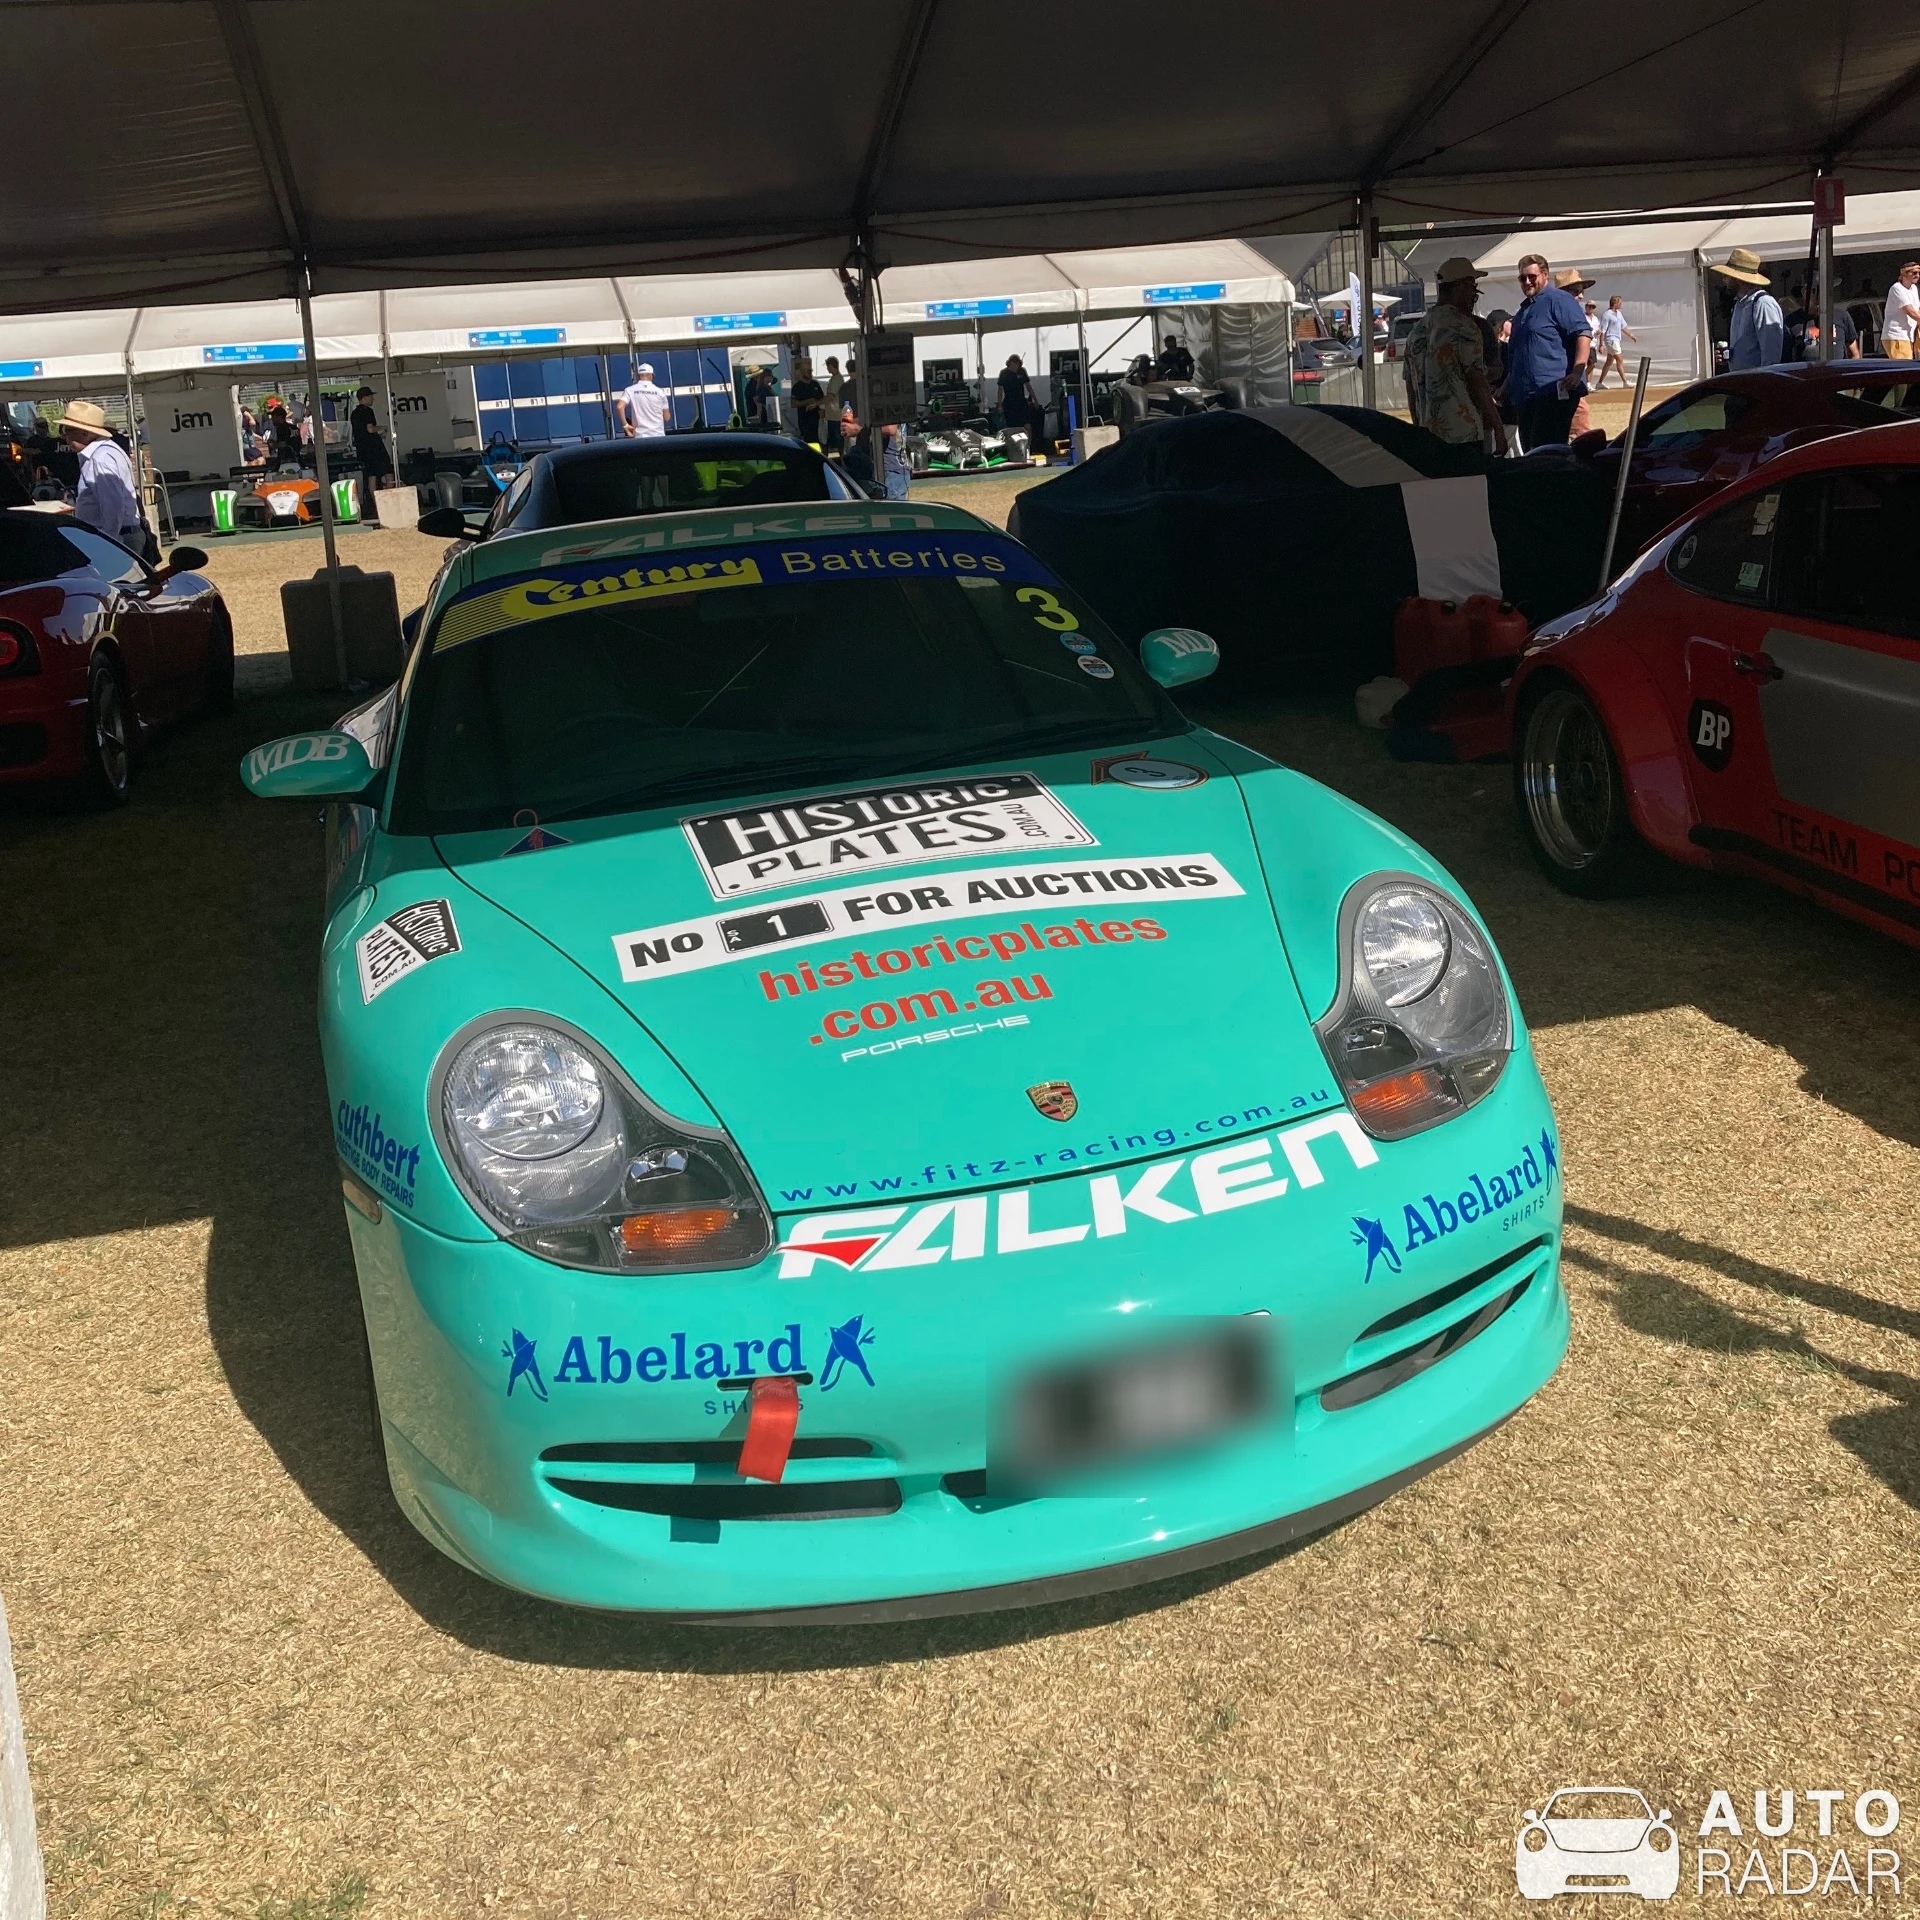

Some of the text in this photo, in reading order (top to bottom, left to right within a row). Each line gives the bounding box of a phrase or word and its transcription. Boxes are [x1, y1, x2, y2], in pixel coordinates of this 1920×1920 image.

[170, 408, 213, 433] jam
[535, 513, 934, 567] FALKEN
[501, 547, 1007, 620] Century Batteries
[1015, 587, 1079, 632] 3
[1696, 709, 1730, 751] BP
[248, 735, 351, 786] MDB
[722, 782, 1011, 856] HISTORIC
[746, 810, 1009, 880] PLATES
[999, 803, 1050, 839] .COM.AU
[1771, 808, 1858, 875] TEAM
[391, 902, 450, 954] HISTORIC
[630, 864, 1219, 968] NO 1 FOR AUCTIONS
[365, 928, 411, 981] PLATES
[372, 957, 416, 991] .COM.AU
[758, 916, 1169, 1003] historicplates
[808, 971, 1055, 1045] .com.au
[841, 1014, 1031, 1063] PORSCHE
[338, 1099, 421, 1189] cuthbert
[780, 1086, 1330, 1203] www.fitz-racing.com.au
[361, 1157, 380, 1184] BODY
[381, 1173, 415, 1210] REPAIRS
[774, 1112, 1380, 1280] FALKEN
[1402, 1144, 1543, 1253] Abelard
[1502, 1197, 1546, 1232] SHIRTS
[553, 1323, 807, 1385] Abelard
[704, 1398, 804, 1415] SHI
